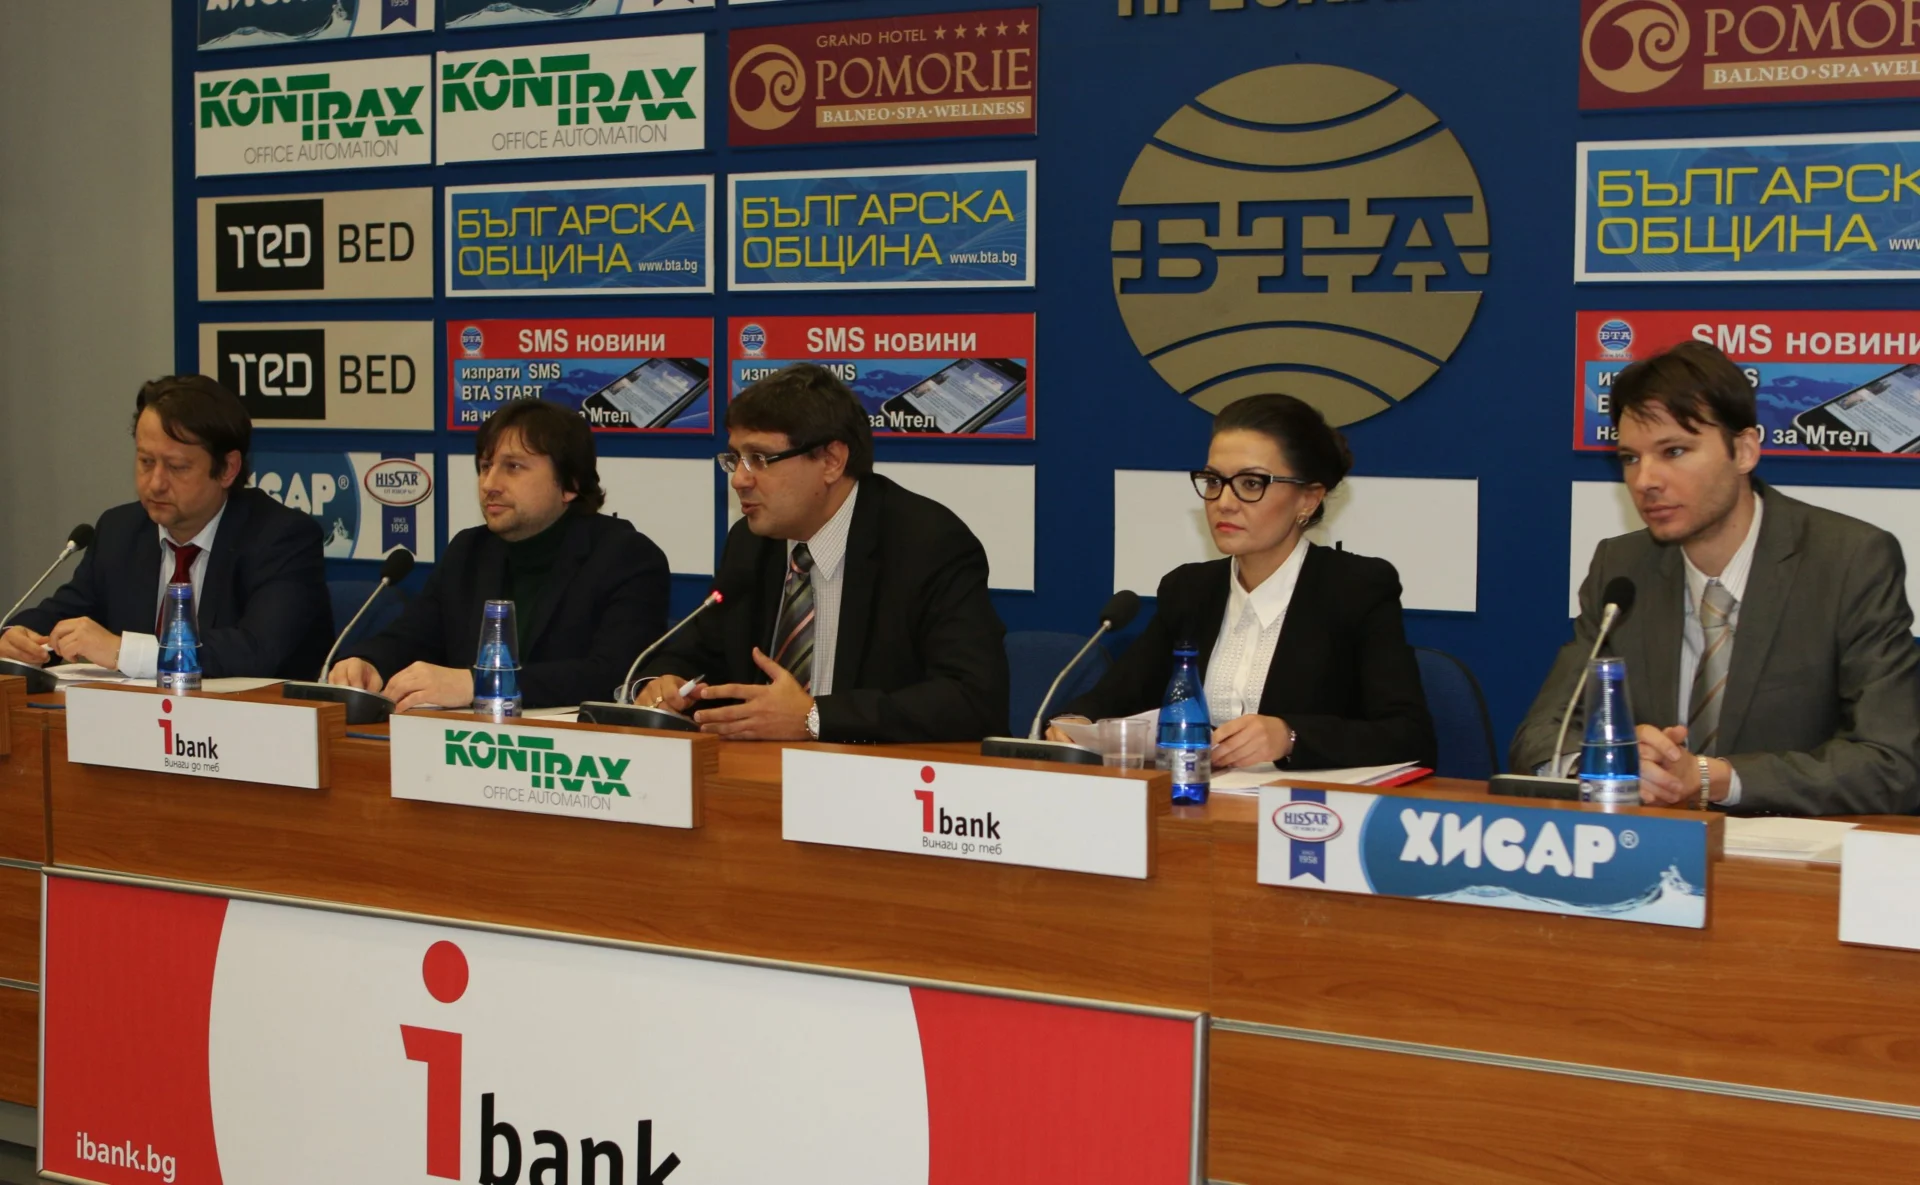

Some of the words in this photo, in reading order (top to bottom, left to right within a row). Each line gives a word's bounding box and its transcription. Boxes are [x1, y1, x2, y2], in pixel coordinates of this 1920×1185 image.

[816, 32, 872, 48] GRAND
[878, 28, 927, 44] HOTEL
[815, 48, 1032, 100] POMORIE
[442, 53, 698, 126] KONTRAX
[200, 73, 425, 141] KONTRAX
[492, 130, 548, 151] OFFICE
[552, 124, 668, 148] AUTOMATION
[244, 144, 293, 165] OFFICE
[298, 139, 399, 163] AUTOMATION
[457, 202, 696, 239] БЪЛГАРСКА
[742, 189, 1015, 229] БЪЛГАРСКА
[338, 221, 415, 264] BED
[1118, 196, 1483, 294] БТА
[1597, 213, 1878, 262] ОБЩИНА
[458, 243, 632, 281] ОБЩИНА
[638, 258, 698, 274] www.bta.bg
[742, 233, 943, 275] ОБЩИНА
[949, 250, 1018, 267] www.bta.bg
[518, 328, 569, 353] SMS
[576, 333, 666, 352] новини
[806, 326, 865, 353] SMS
[874, 332, 977, 352] новини
[339, 354, 416, 395] BED
[462, 367, 520, 383] изпрати
[528, 363, 561, 379] SMS
[494, 385, 543, 400] START
[461, 410, 478, 422] на
[590, 407, 630, 423] Мтел
[890, 411, 935, 428] Мтел
[1772, 428, 1798, 445] за
[1805, 424, 1869, 446] Мтел
[375, 471, 419, 488] HISSAR
[390, 523, 409, 533] 1958
[445, 729, 631, 797] KONTRAX
[483, 785, 525, 802] OFFICE
[528, 790, 611, 811] AUTOMATION
[1284, 811, 1330, 826] HISSAR
[76, 1131, 176, 1183] ibank.bg
